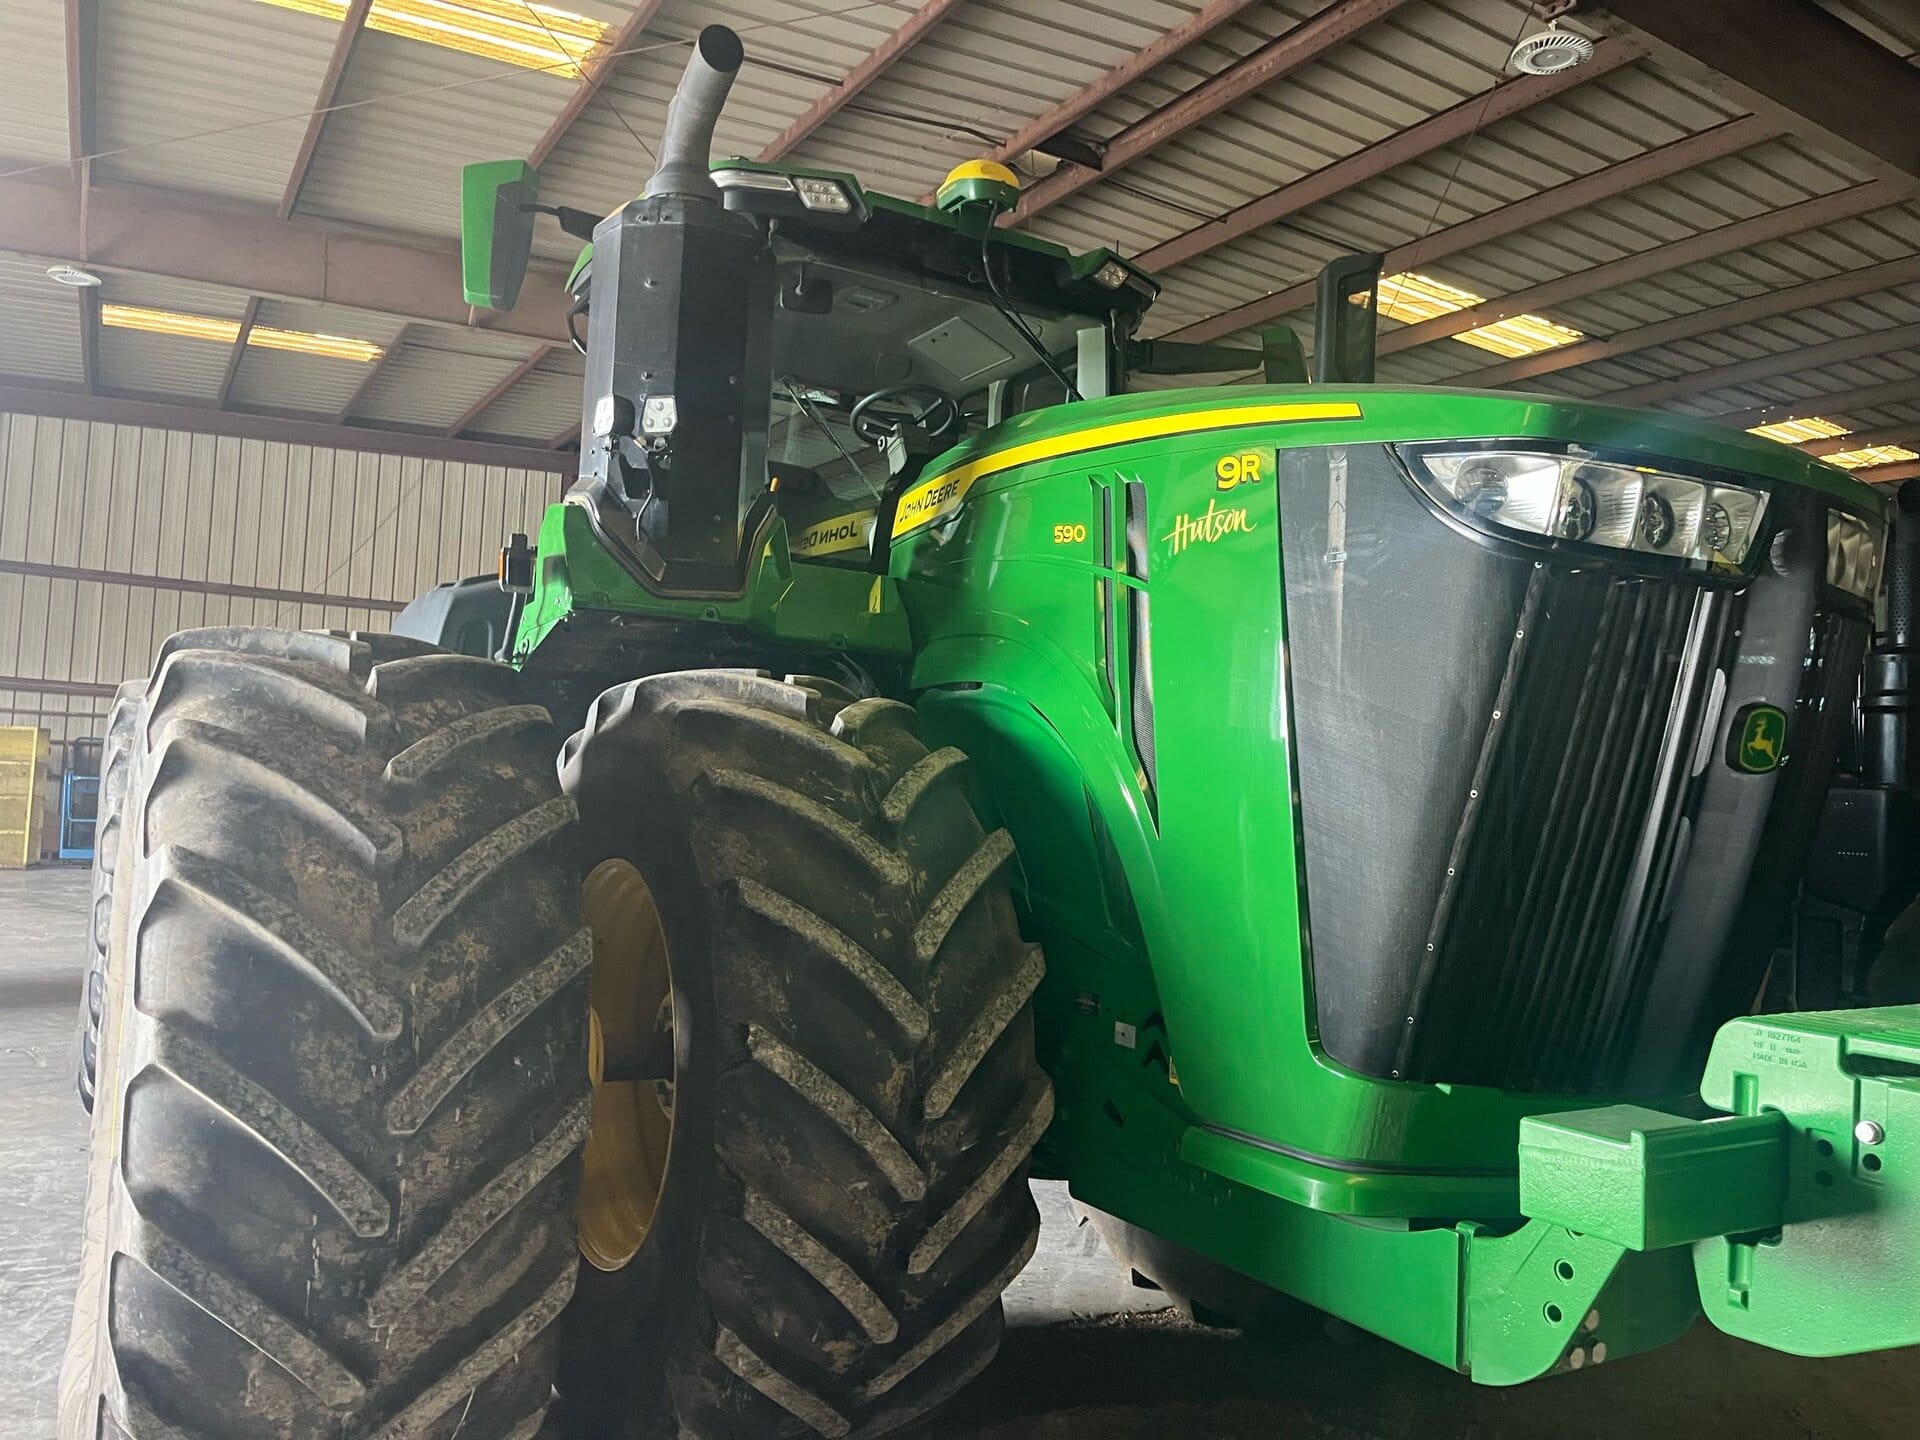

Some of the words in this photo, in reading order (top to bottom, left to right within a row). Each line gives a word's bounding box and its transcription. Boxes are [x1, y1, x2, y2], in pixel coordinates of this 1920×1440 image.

[1216, 454, 1261, 491] 9R
[899, 501, 924, 522] JOHN
[924, 479, 960, 508] DEERE
[1053, 523, 1087, 544] 590
[1161, 498, 1258, 555] Hutson
[1752, 1051, 1776, 1063] MADE
[1791, 1059, 1807, 1069] USA
